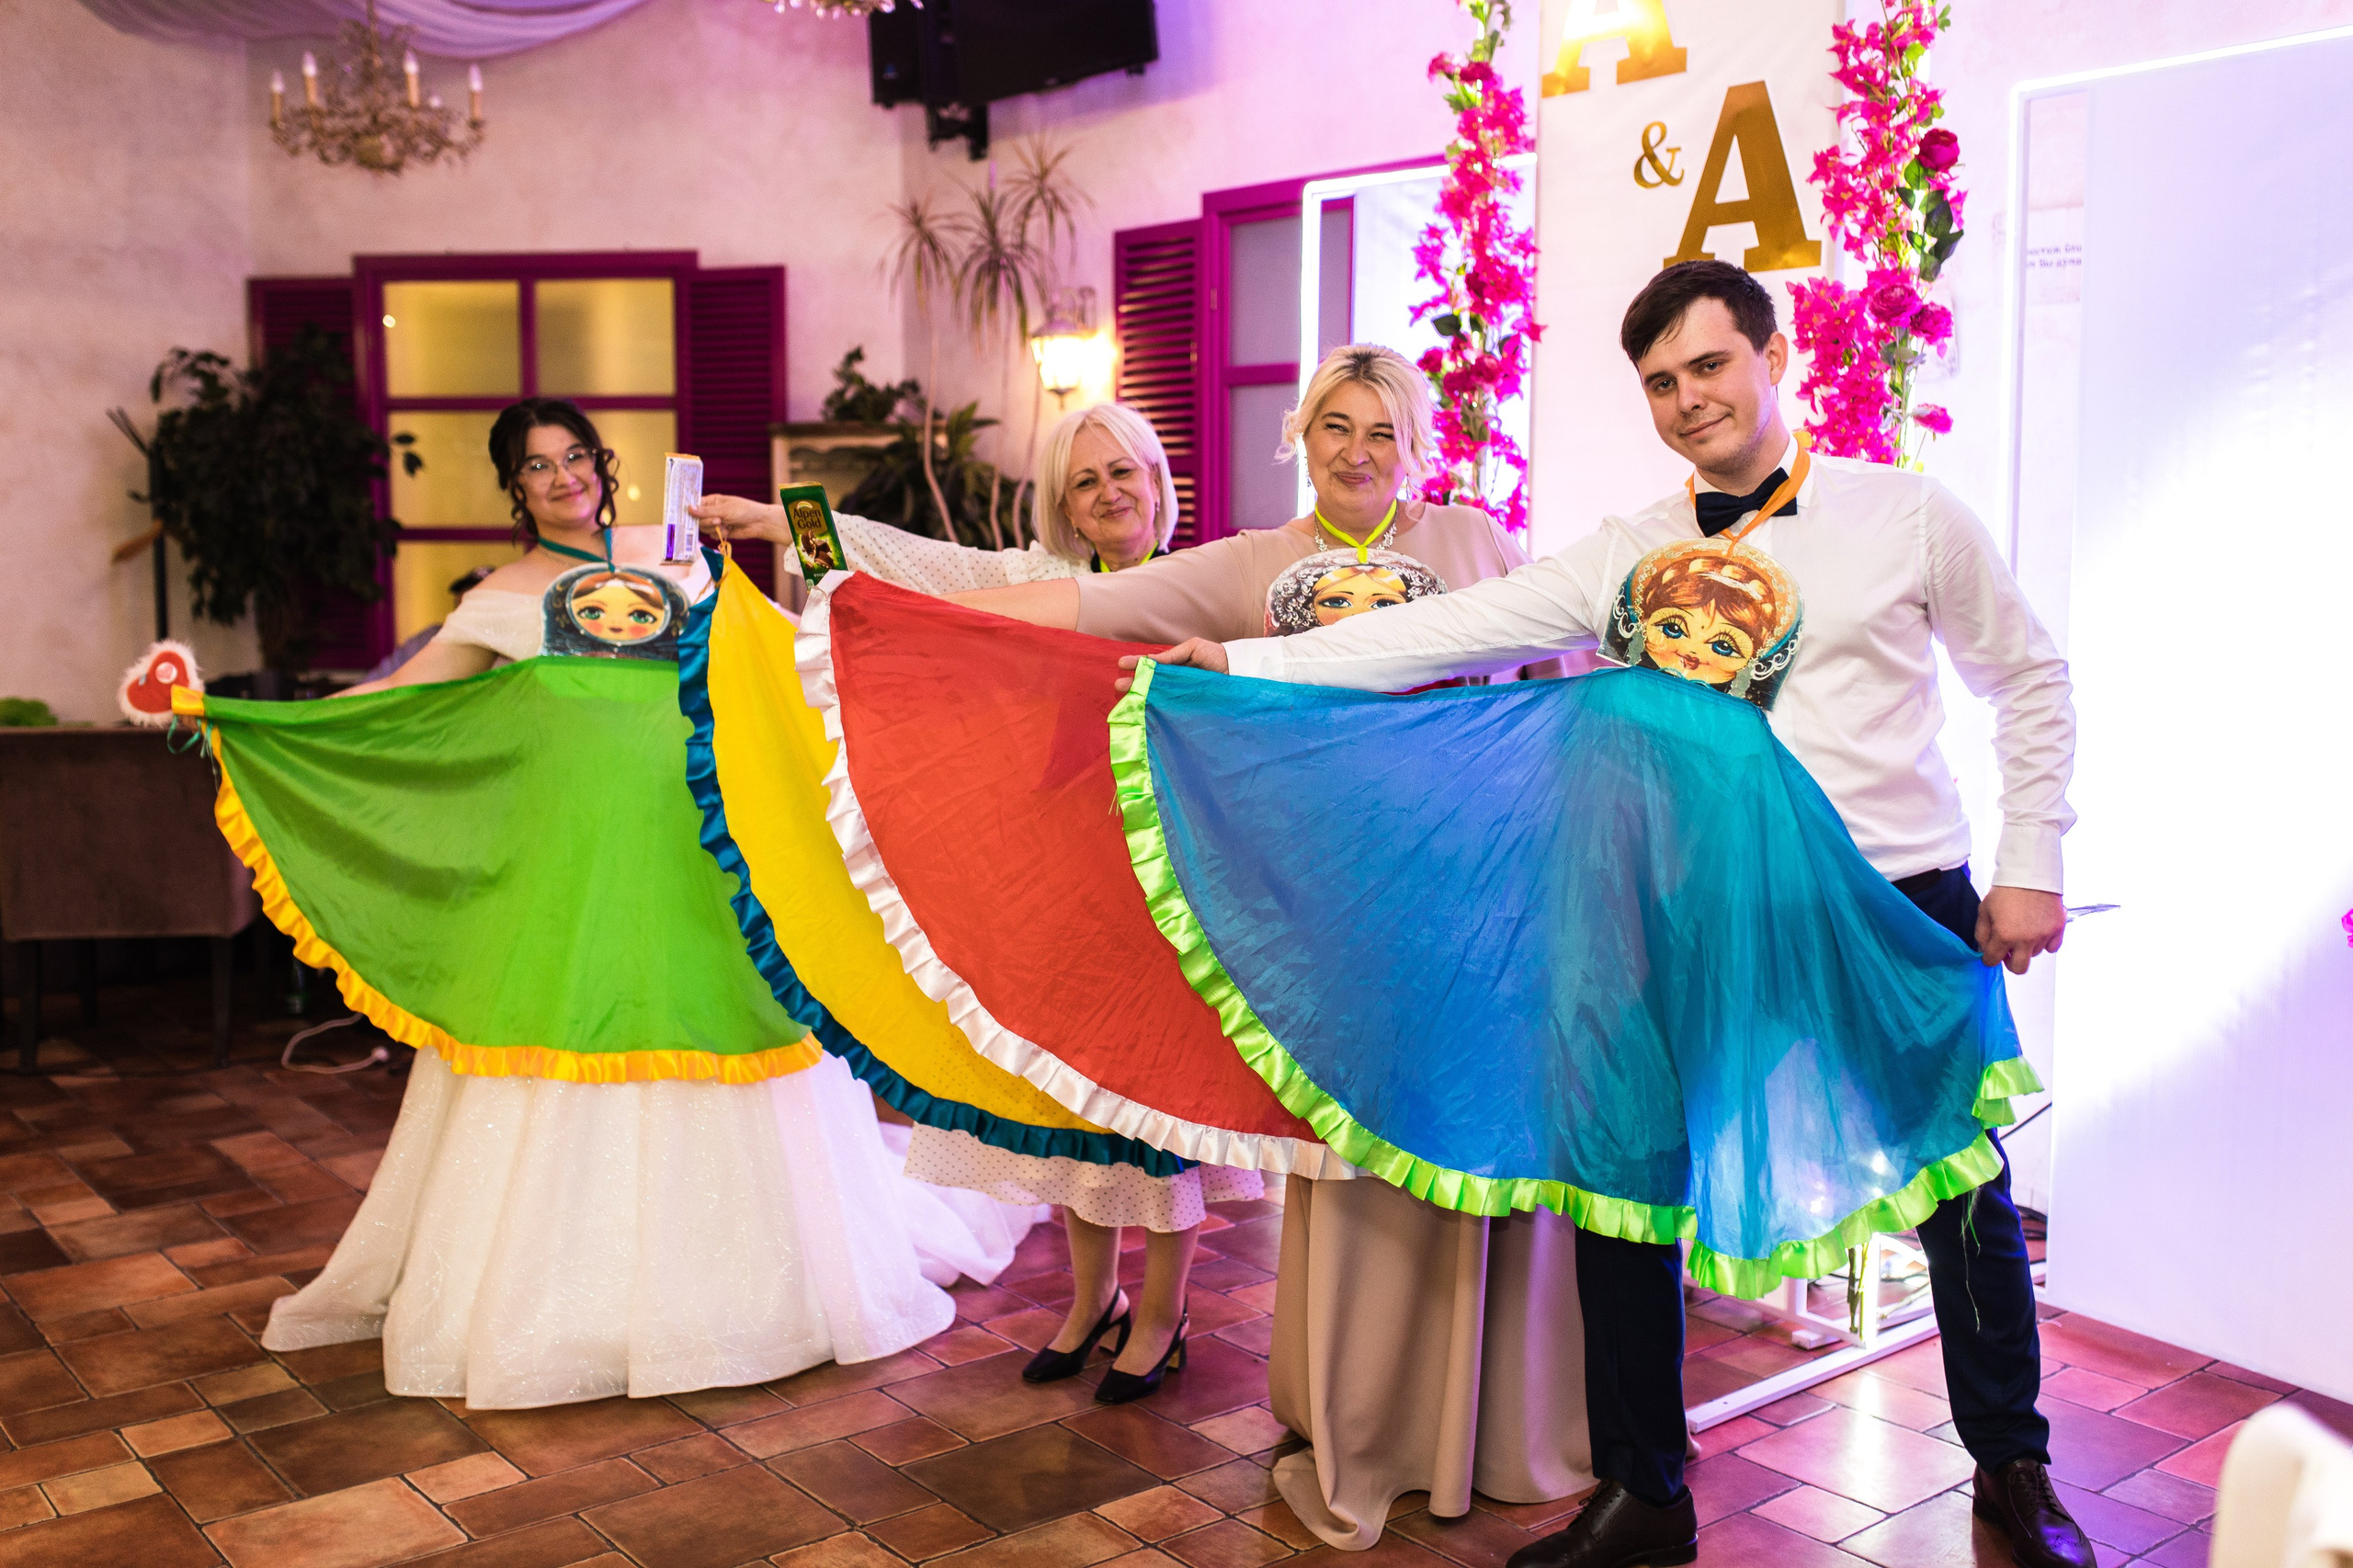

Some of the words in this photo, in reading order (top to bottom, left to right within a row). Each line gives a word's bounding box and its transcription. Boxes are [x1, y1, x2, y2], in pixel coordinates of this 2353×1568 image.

[1633, 120, 1685, 189] &
[1663, 80, 1822, 273] A
[793, 507, 821, 521] Alpen
[797, 517, 822, 528] Gold
